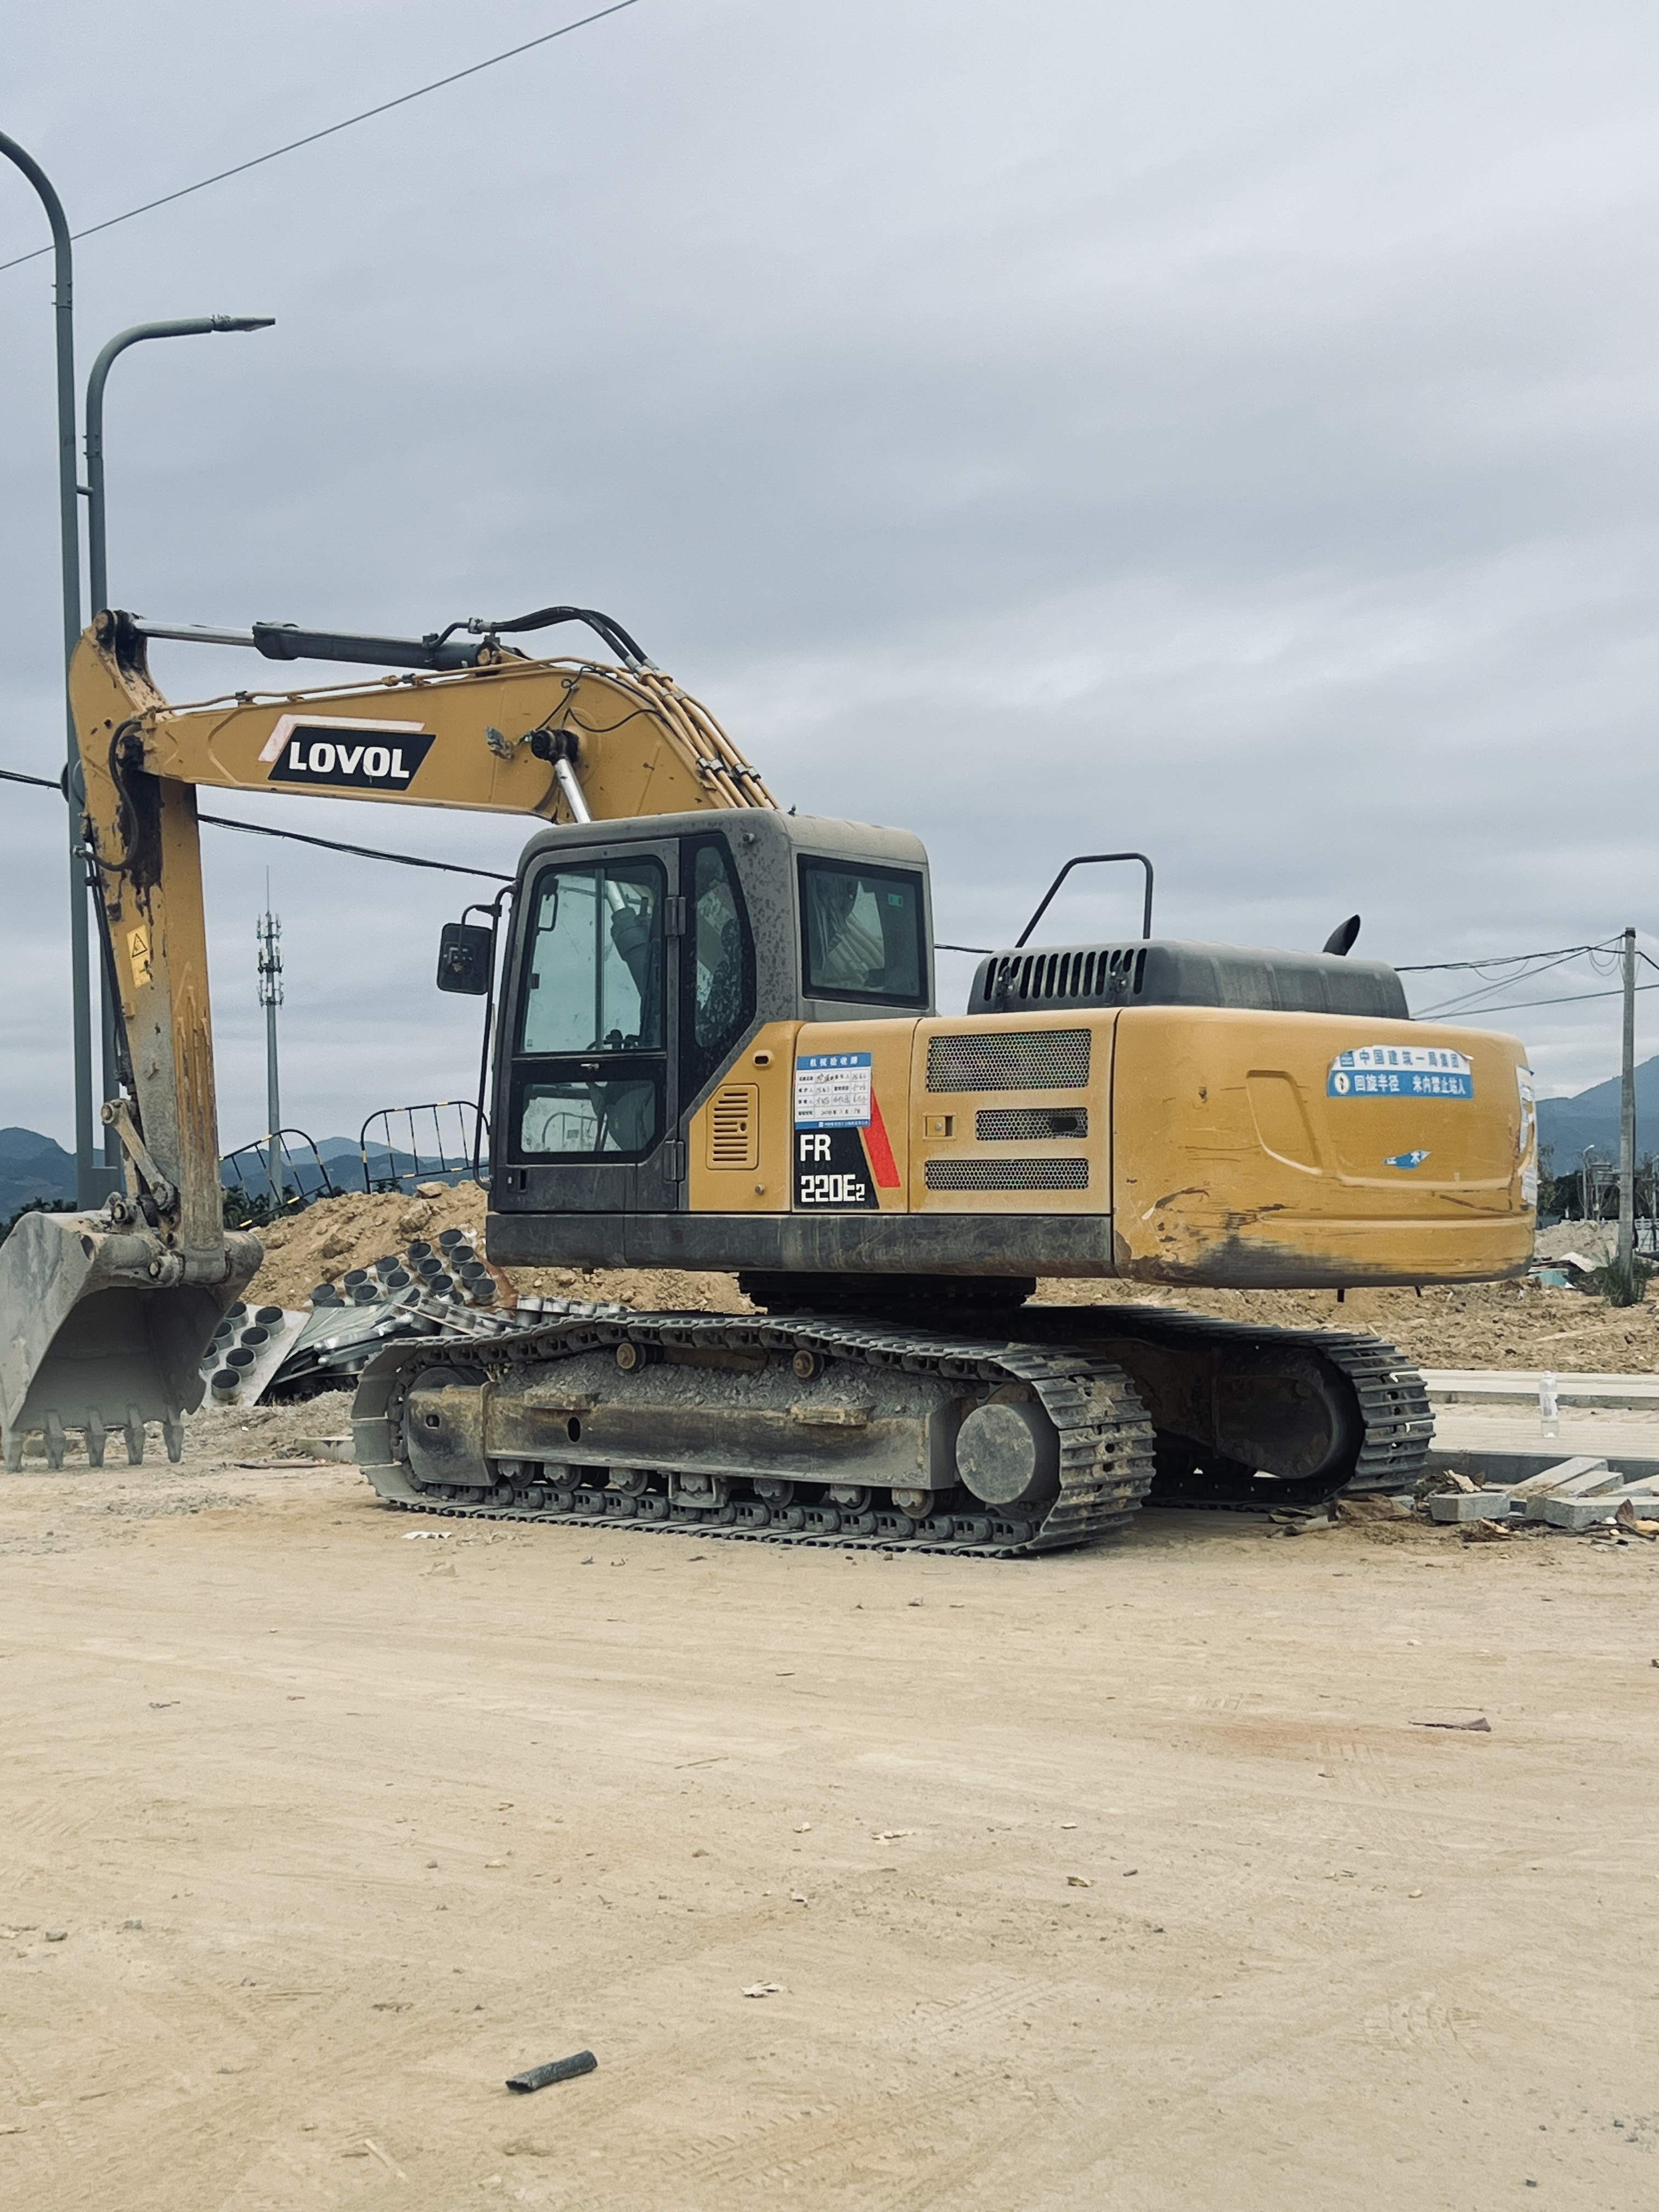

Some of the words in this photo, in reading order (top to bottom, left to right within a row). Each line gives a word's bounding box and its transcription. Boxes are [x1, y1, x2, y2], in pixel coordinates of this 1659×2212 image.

[289, 742, 410, 778] LOVOL
[1354, 1074, 1401, 1093] 回旋半径
[800, 1133, 831, 1161] FR
[801, 1173, 865, 1203] 220E2
